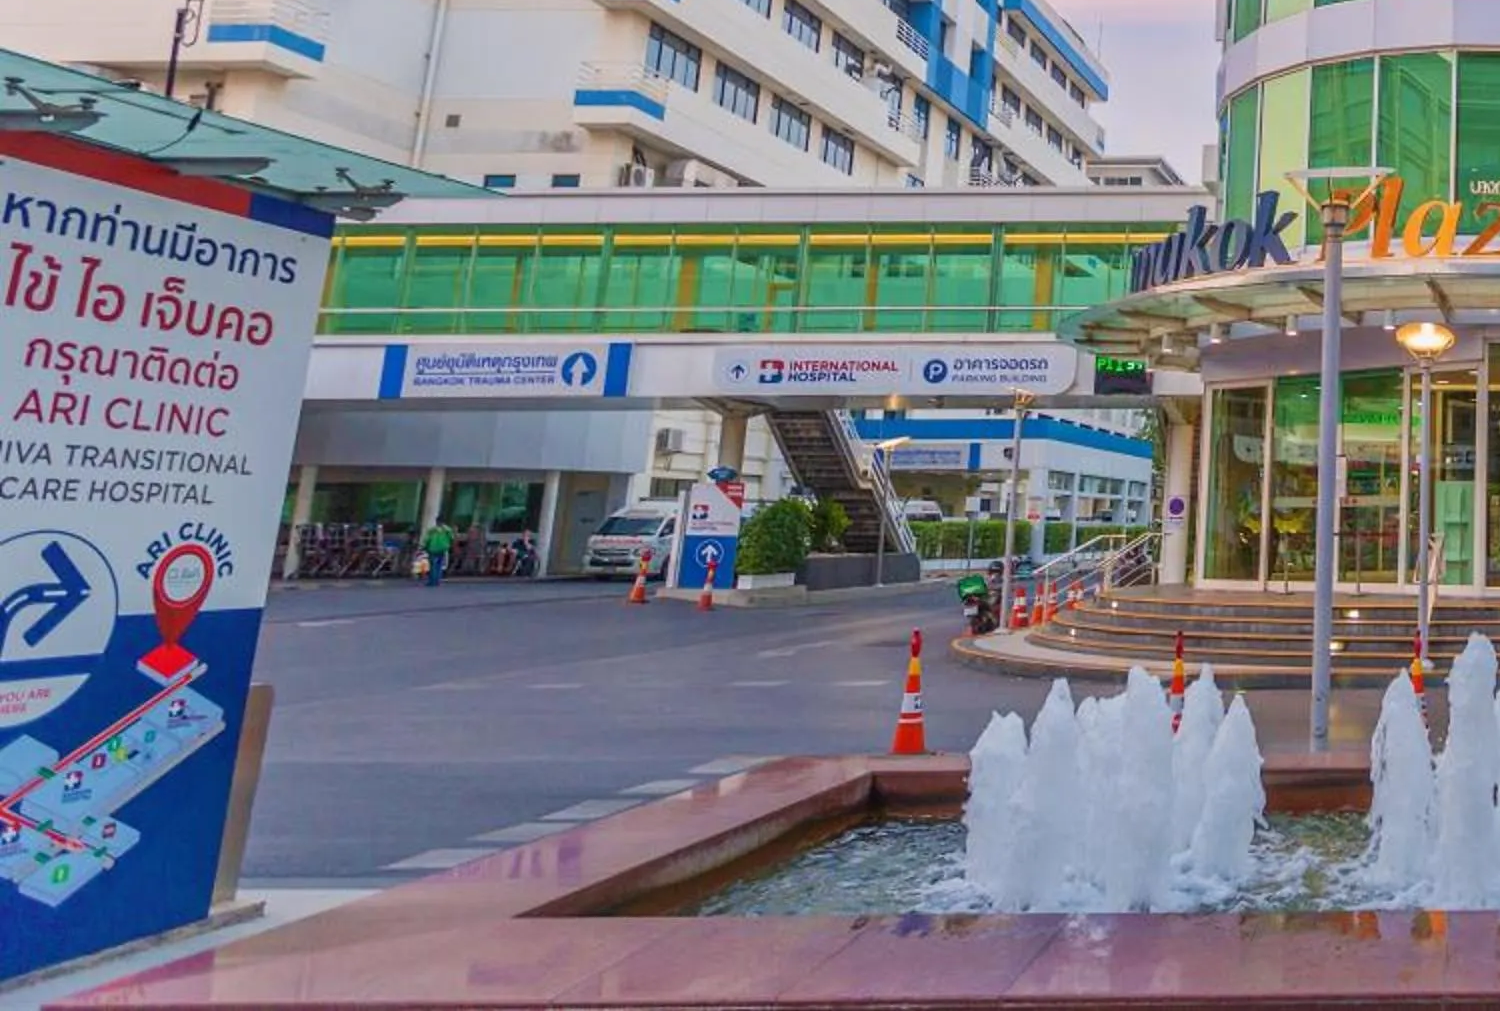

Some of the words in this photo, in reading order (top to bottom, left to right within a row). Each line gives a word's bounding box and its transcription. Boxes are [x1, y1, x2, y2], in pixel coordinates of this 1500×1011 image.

[3, 192, 298, 284] หากท่านมีอาการ
[5, 242, 62, 312] ไข้
[75, 256, 126, 323] ไอ
[140, 276, 274, 346] เจ็บคอ
[24, 336, 240, 391] กรุณาติดต่อ
[787, 372, 857, 382] HOSPITAL
[789, 360, 898, 372] INTERNATIONAL
[952, 375, 997, 383] PARKING
[1000, 375, 1047, 383] BUILDING
[953, 358, 1049, 371] อาคารจอดรถ
[514, 376, 555, 385] CENTER
[13, 389, 91, 426] ARI
[105, 397, 230, 437] CLINIC
[0, 439, 52, 466] IVA
[65, 444, 253, 476] TRANSITIONAL
[0, 476, 80, 502] CARE
[87, 480, 214, 505] HOSPITAL
[136, 532, 172, 580] ARI
[179, 522, 233, 579] CLINIC
